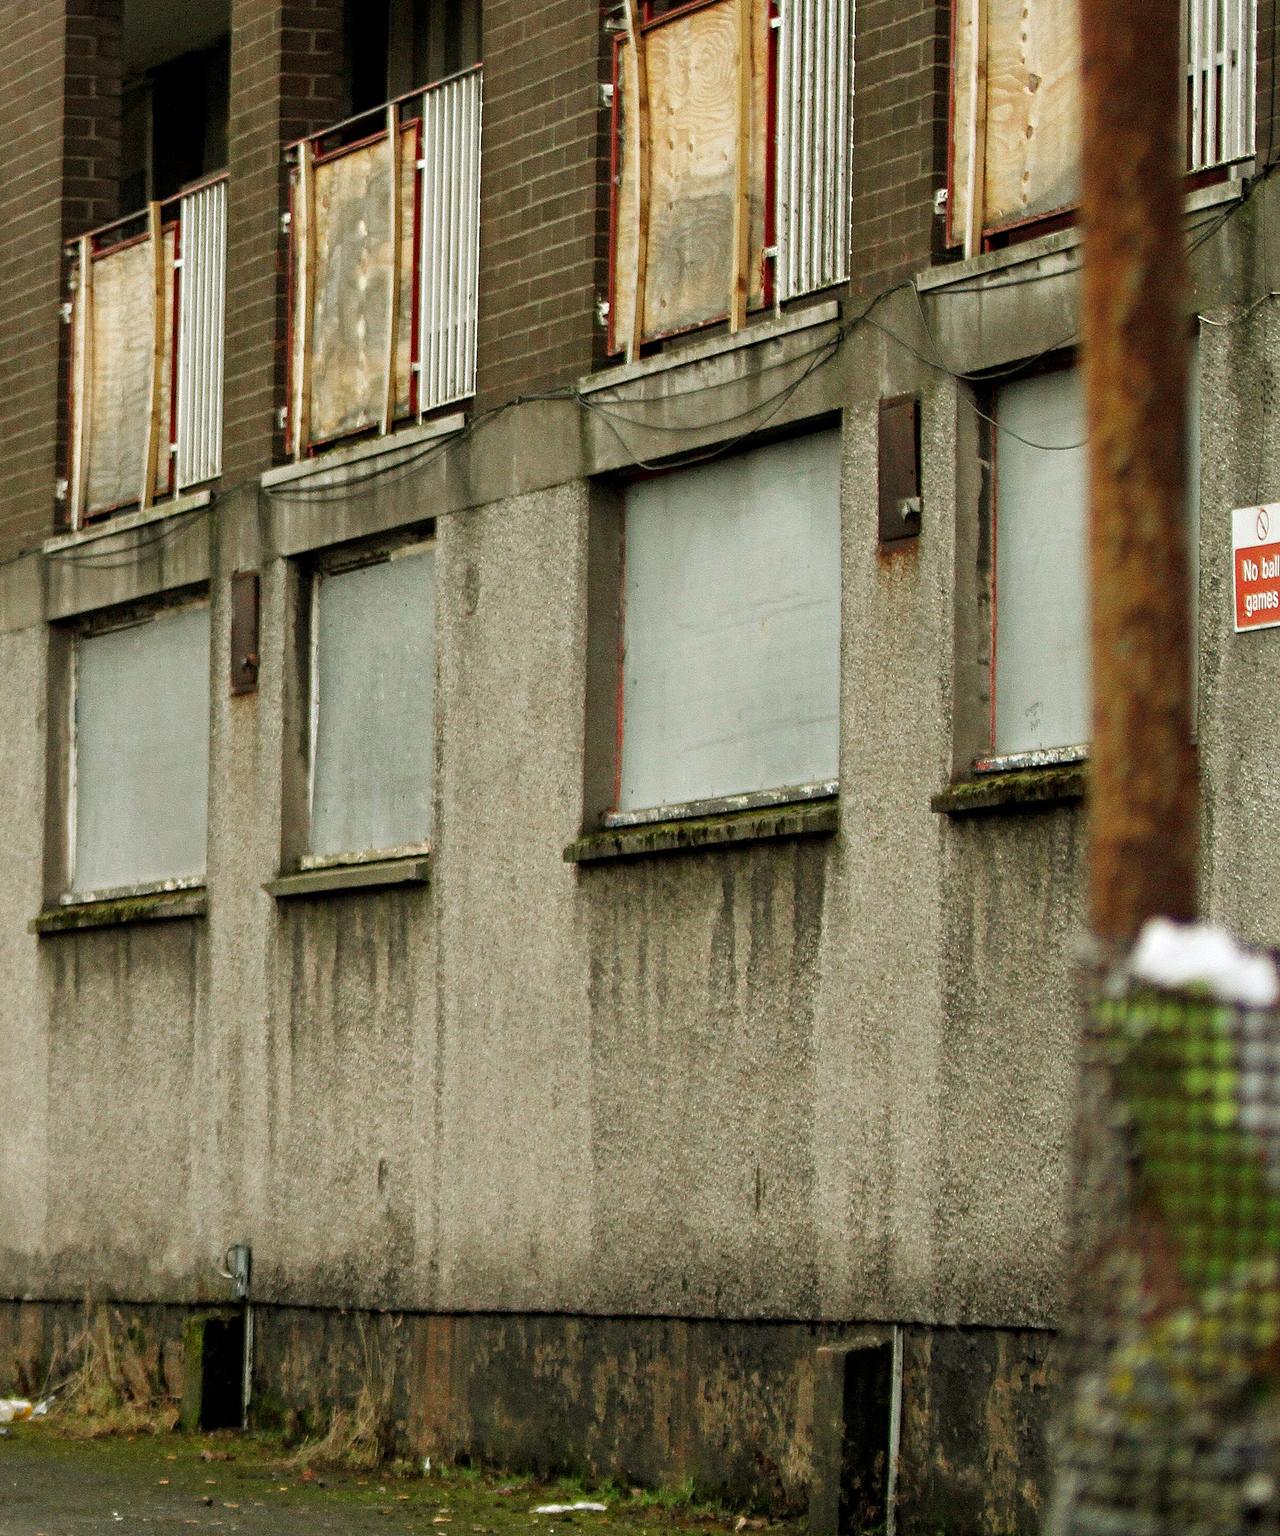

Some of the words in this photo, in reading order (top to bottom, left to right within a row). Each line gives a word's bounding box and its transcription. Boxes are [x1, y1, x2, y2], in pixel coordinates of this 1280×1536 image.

[1243, 559, 1259, 582] No
[1262, 555, 1280, 580] ball
[1245, 590, 1279, 617] games
